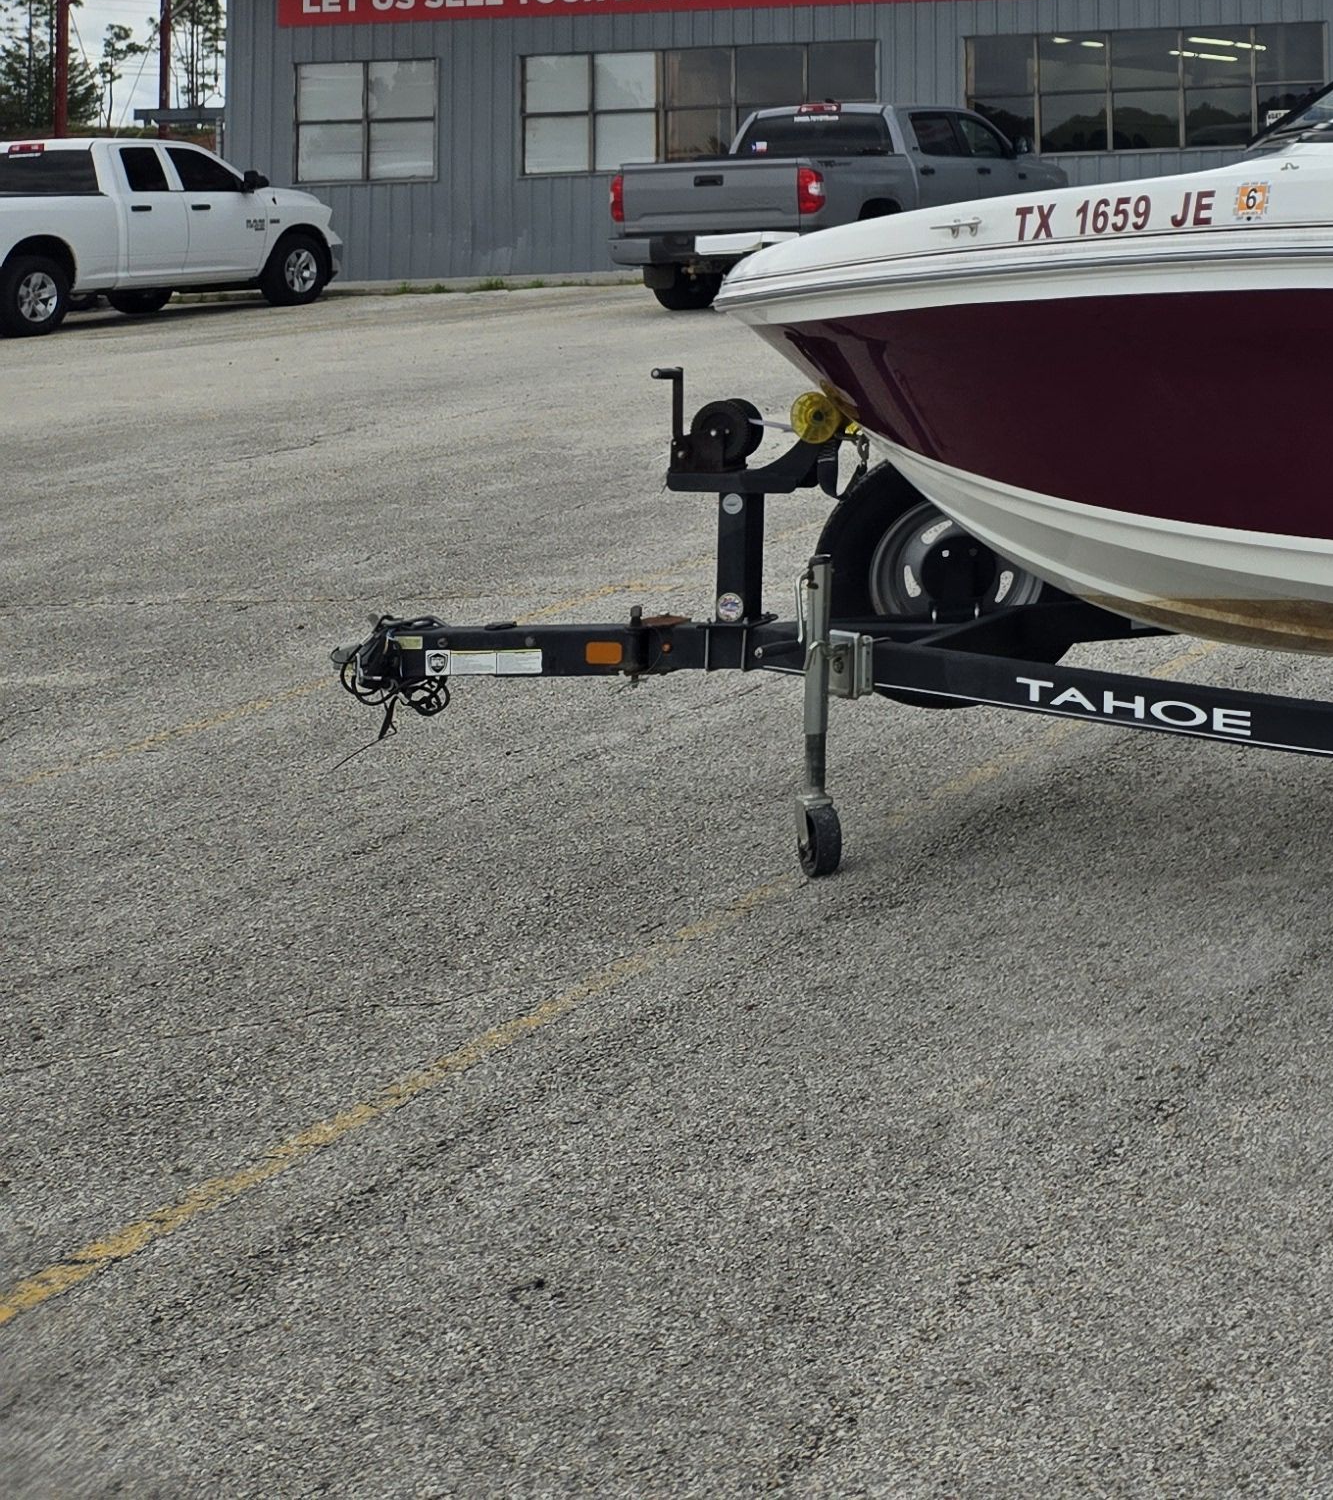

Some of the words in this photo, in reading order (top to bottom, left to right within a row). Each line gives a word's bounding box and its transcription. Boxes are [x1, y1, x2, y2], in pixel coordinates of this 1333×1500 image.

[1015, 203, 1057, 241] TX
[1075, 195, 1151, 235] 1659
[1171, 190, 1216, 227] JE
[1246, 188, 1257, 210] 6
[1016, 677, 1251, 736] TAHOE
